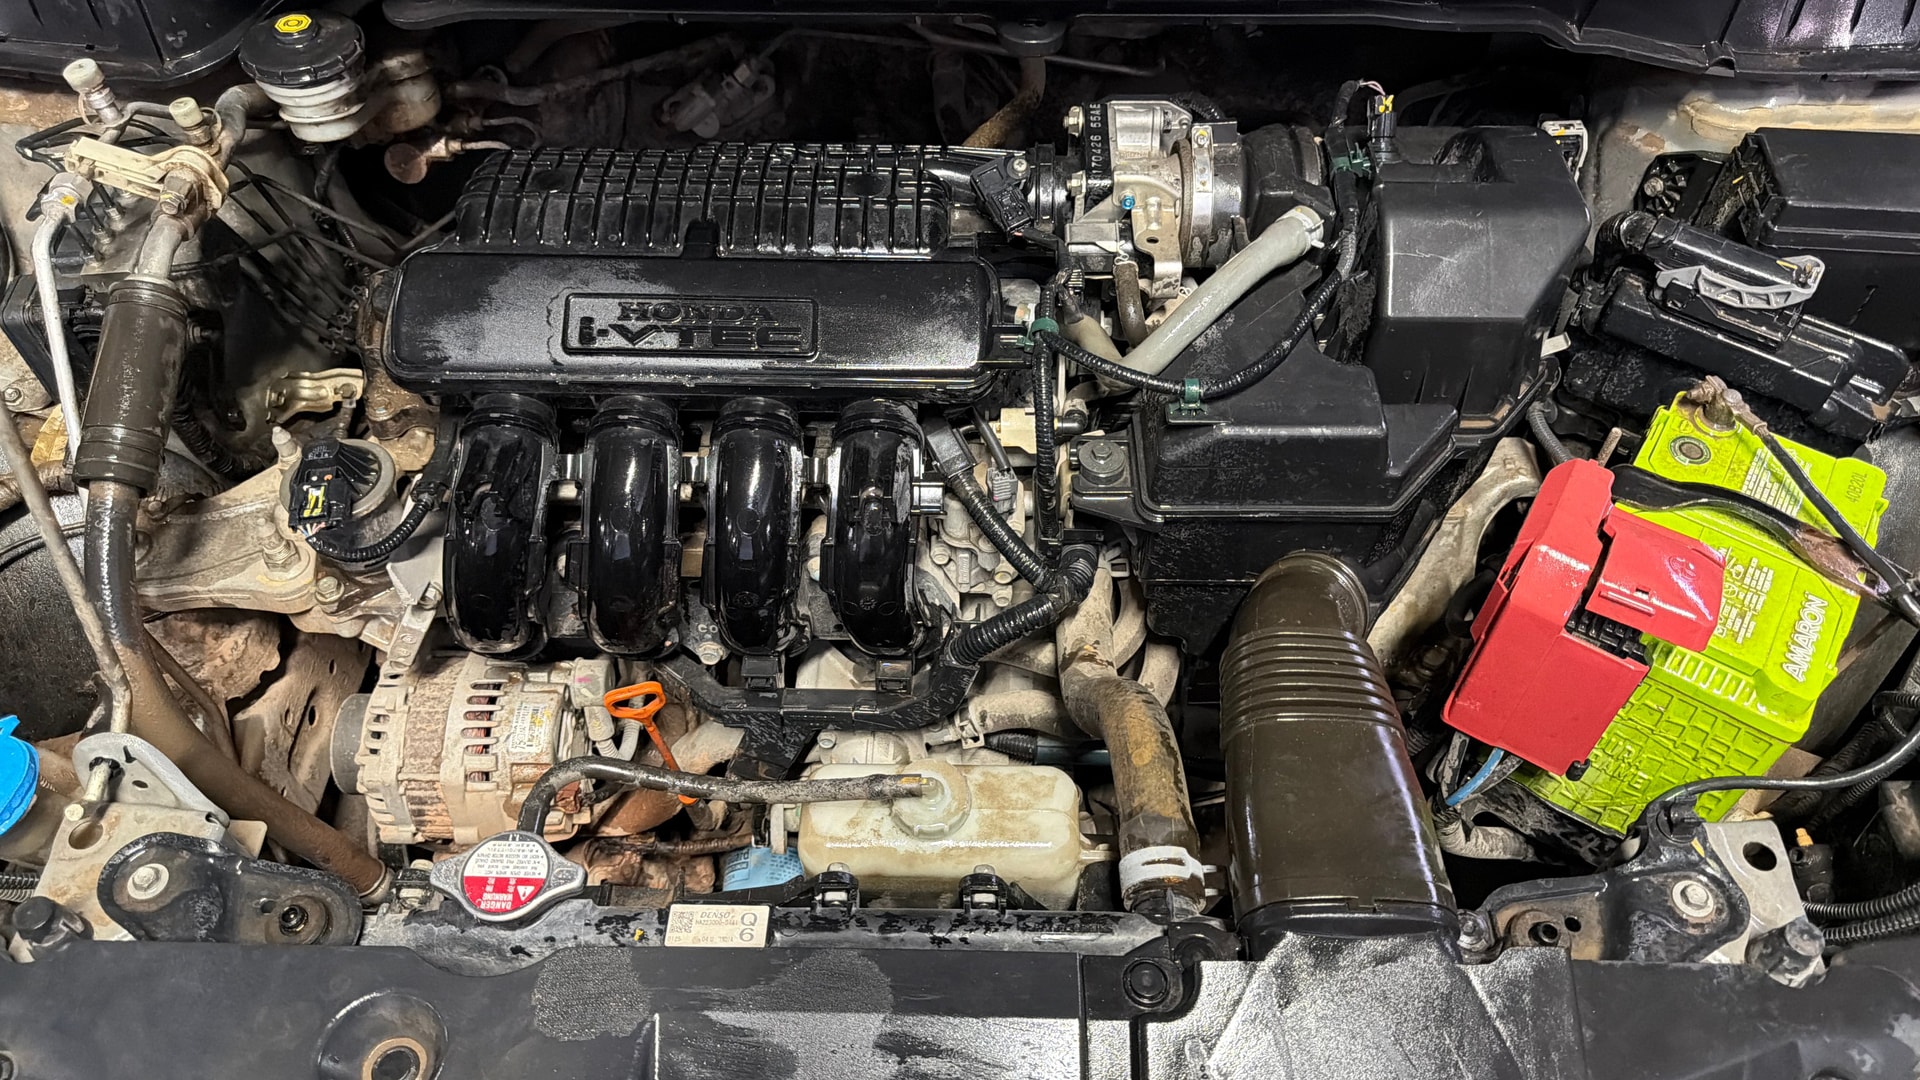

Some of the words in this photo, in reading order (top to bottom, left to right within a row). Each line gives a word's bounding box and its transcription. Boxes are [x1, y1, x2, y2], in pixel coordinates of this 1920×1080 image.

[617, 301, 779, 326] HONDA
[1782, 591, 1829, 683] AMARON
[480, 901, 512, 909] DANGER
[699, 911, 731, 919] DENSO
[740, 912, 758, 927] Q
[739, 927, 754, 942] 6
